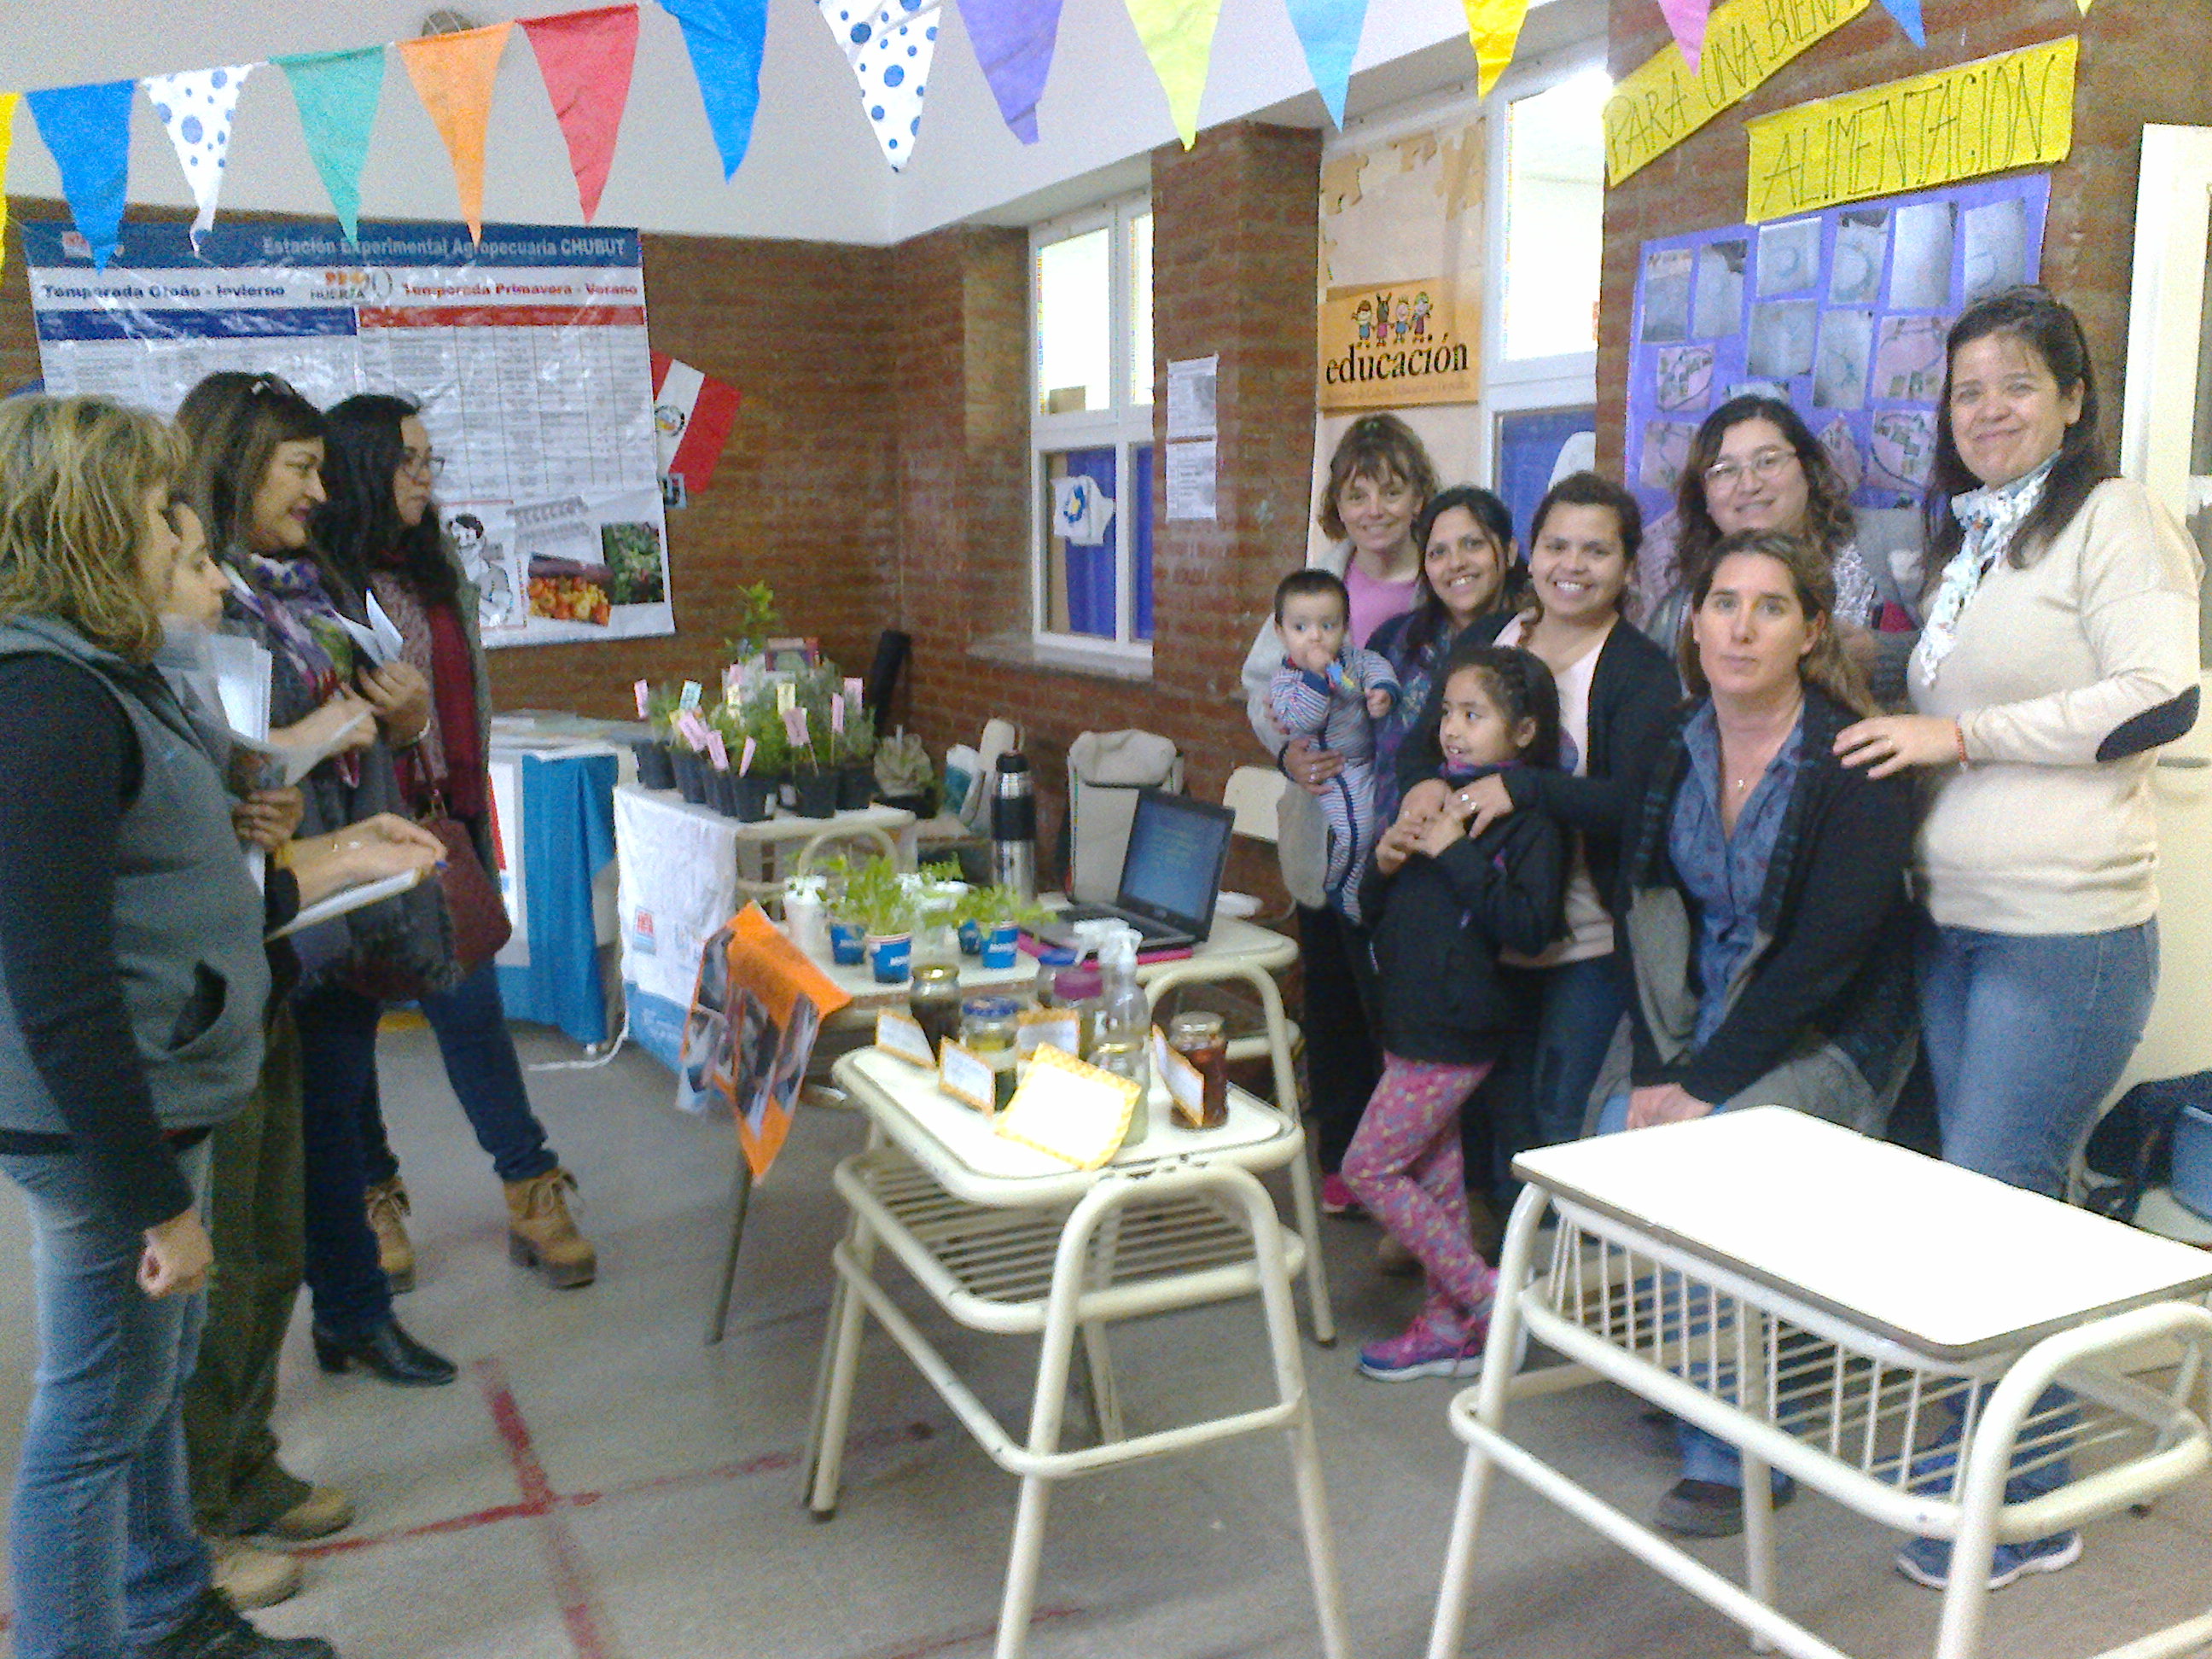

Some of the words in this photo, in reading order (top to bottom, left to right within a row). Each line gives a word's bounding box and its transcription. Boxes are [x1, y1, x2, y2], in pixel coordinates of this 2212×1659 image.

[1602, 70, 1688, 175] PARA
[1701, 20, 1764, 109] UNA
[561, 238, 626, 255] CHUBUT
[216, 285, 285, 298] Invierno
[496, 282, 573, 295] Primavera
[585, 282, 638, 295] Verano
[1326, 332, 1469, 385] educación
